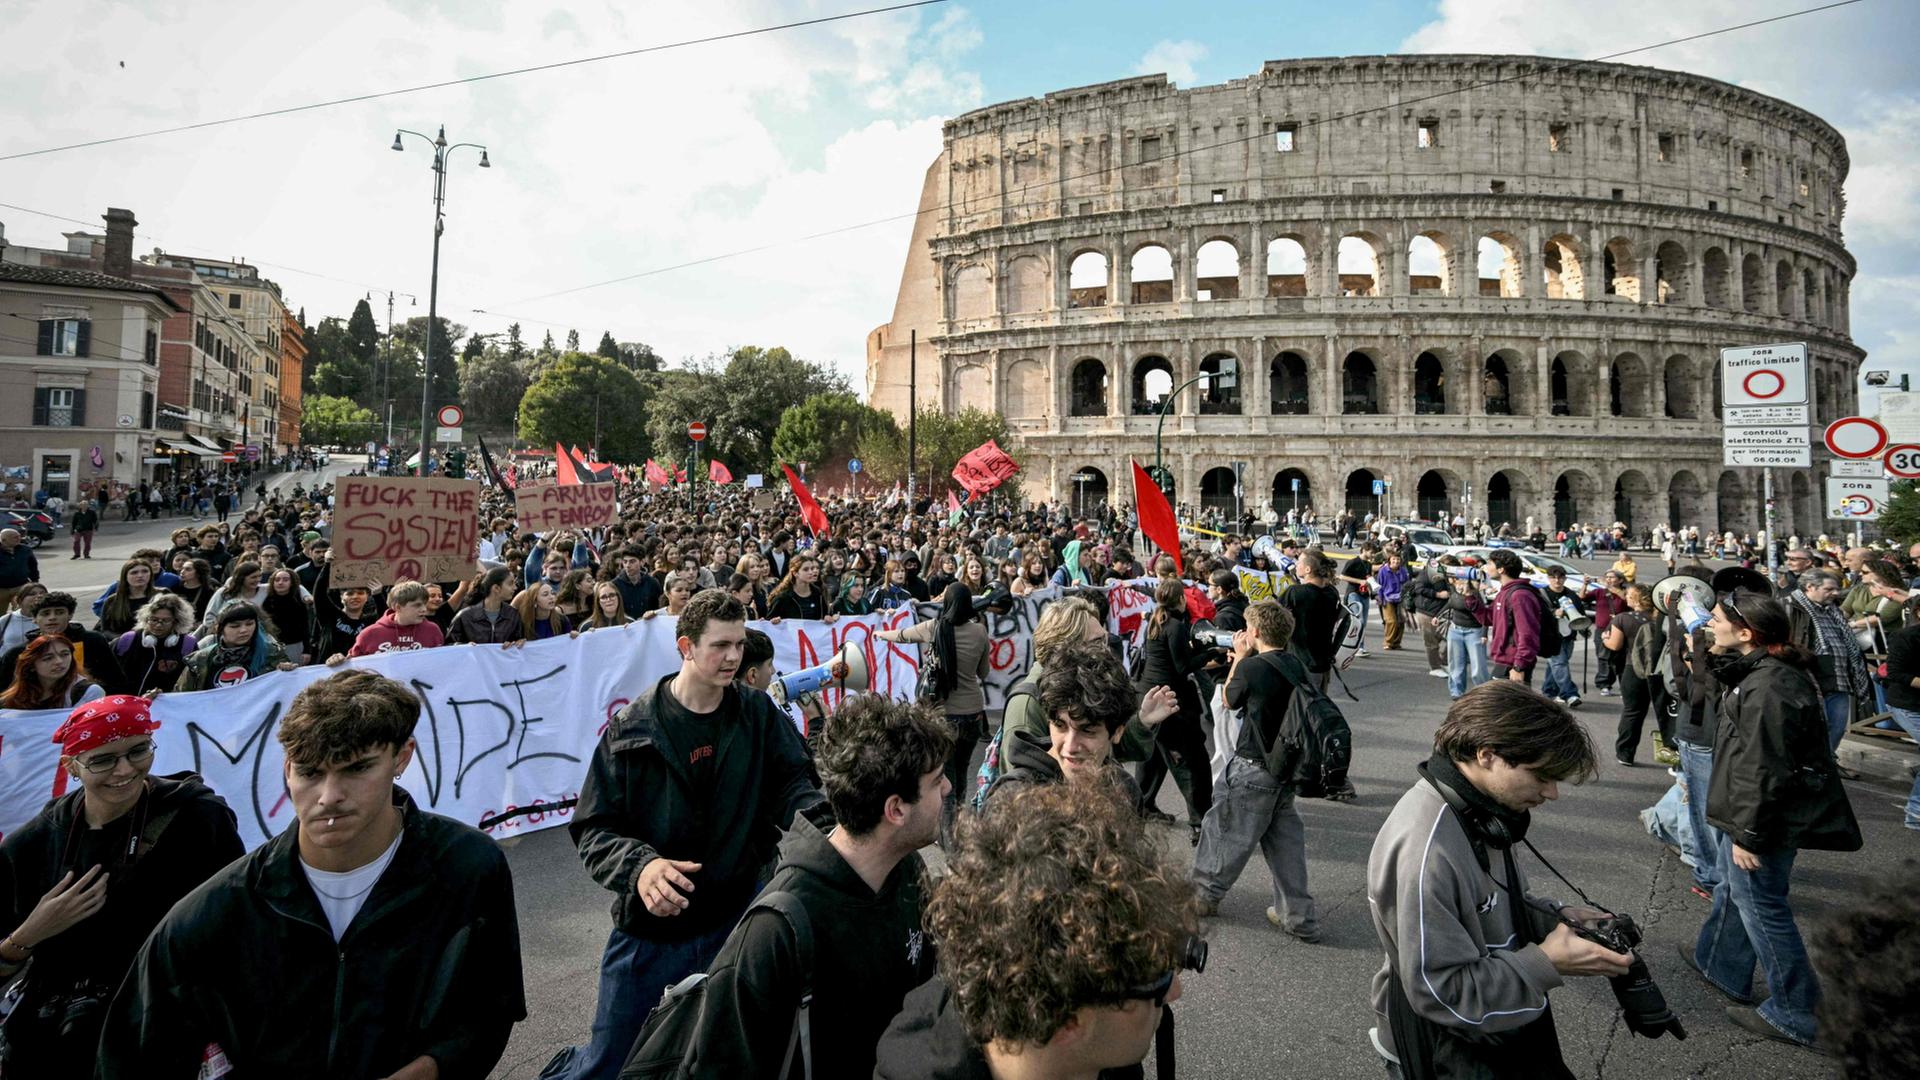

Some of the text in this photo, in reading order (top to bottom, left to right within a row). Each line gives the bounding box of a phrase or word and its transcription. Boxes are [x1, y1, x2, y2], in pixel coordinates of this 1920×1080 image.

[1728, 356, 1800, 367] traffico limitato
[1895, 453, 1920, 469] 30
[344, 483, 474, 513] FUCK THE
[543, 485, 597, 504] ARMI
